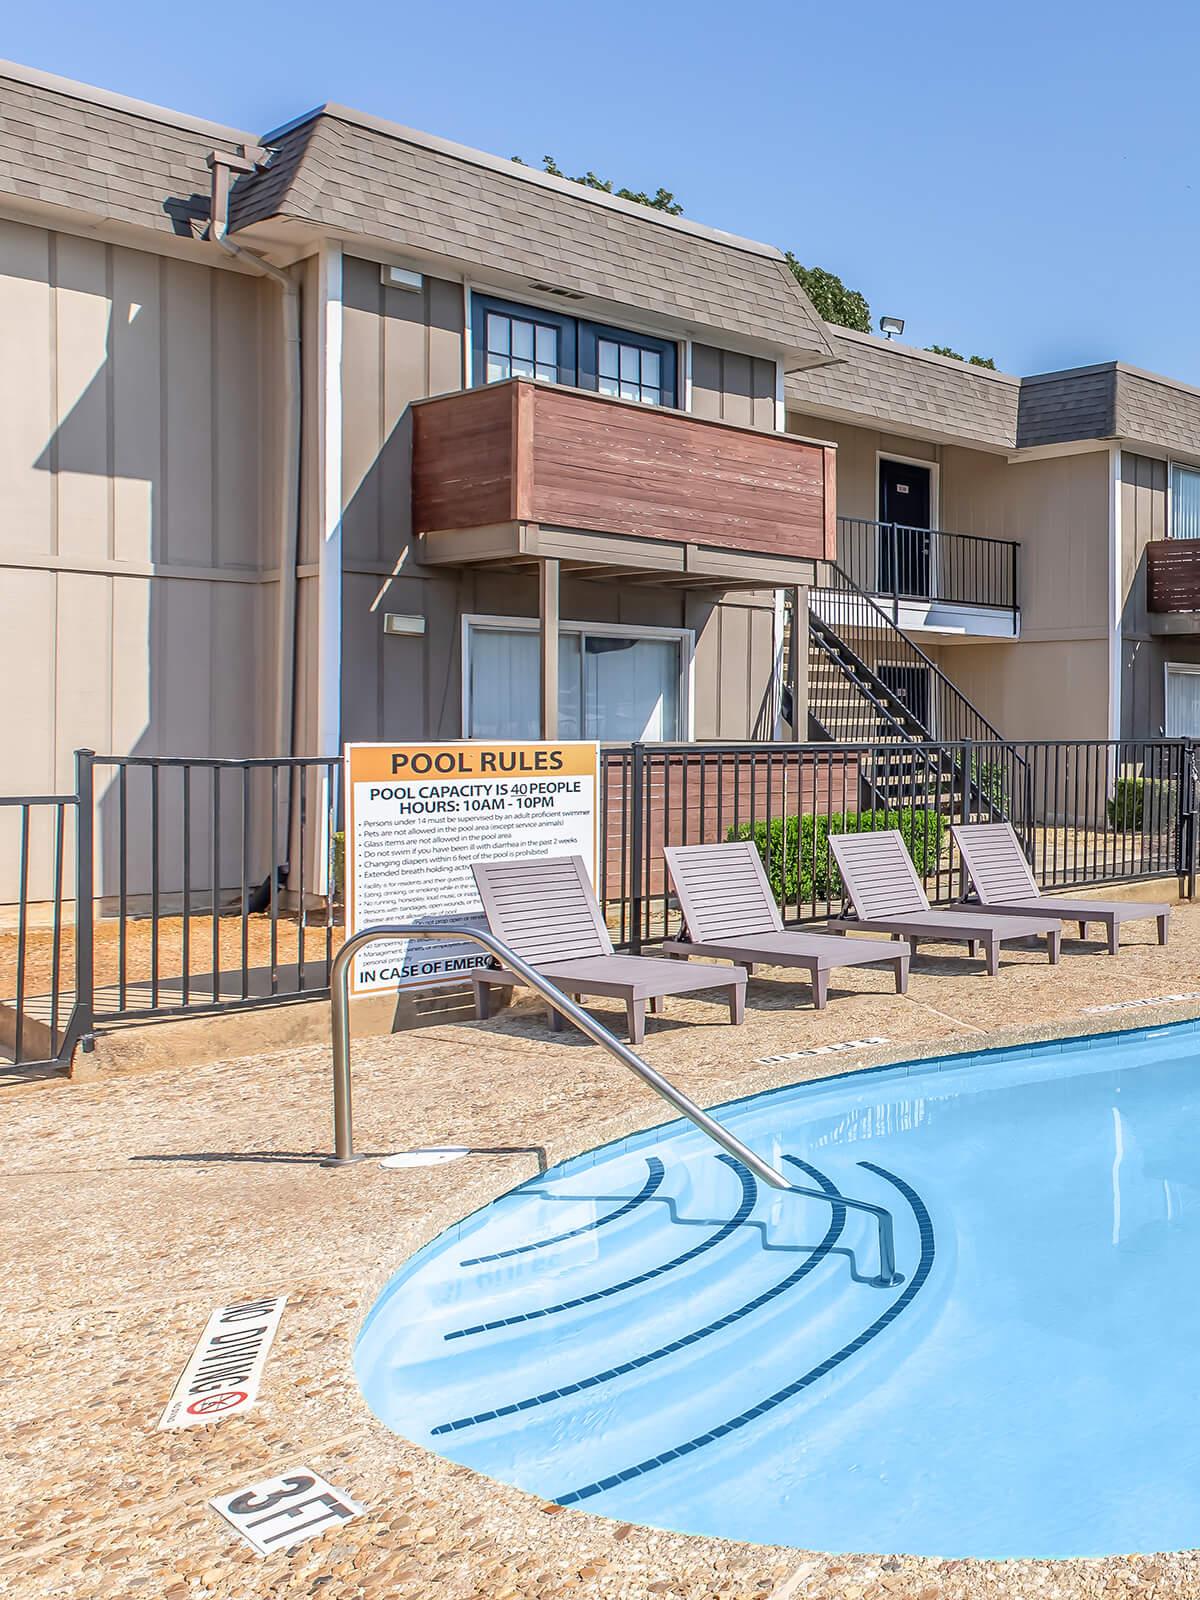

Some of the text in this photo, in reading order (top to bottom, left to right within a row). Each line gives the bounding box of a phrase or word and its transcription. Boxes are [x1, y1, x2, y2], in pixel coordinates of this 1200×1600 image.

[391, 750, 563, 774] POOL RULES
[370, 781, 581, 801] POOL CAPACITY IS 40 PEOPLE
[400, 800, 460, 815] HOURS:
[463, 798, 505, 812] 10AM
[517, 796, 554, 809] 10PM
[364, 820, 392, 828] Persons
[457, 814, 494, 823] supervised
[531, 810, 561, 819] proficient
[364, 830, 380, 838] Pets
[408, 827, 436, 835] allowed
[458, 825, 474, 833] pool
[364, 840, 384, 848] Glass
[385, 839, 405, 847] items
[418, 837, 431, 845] not
[481, 833, 497, 842] pool
[377, 849, 390, 857] not
[417, 848, 431, 856] you
[492, 841, 520, 849] diarrhea
[540, 838, 553, 846] past
[364, 860, 401, 869] Changing
[493, 852, 508, 860] pool
[515, 848, 548, 857] prohibited
[364, 869, 400, 878] Extended
[400, 867, 425, 876] breath
[426, 864, 453, 874] holding
[360, 970, 376, 983] IN
[379, 965, 419, 981] CASE
[421, 961, 442, 975] OF
[826, 1042, 856, 1052] FT
[187, 1298, 279, 1396] NO DIVING
[227, 1475, 355, 1545] 3 FT
